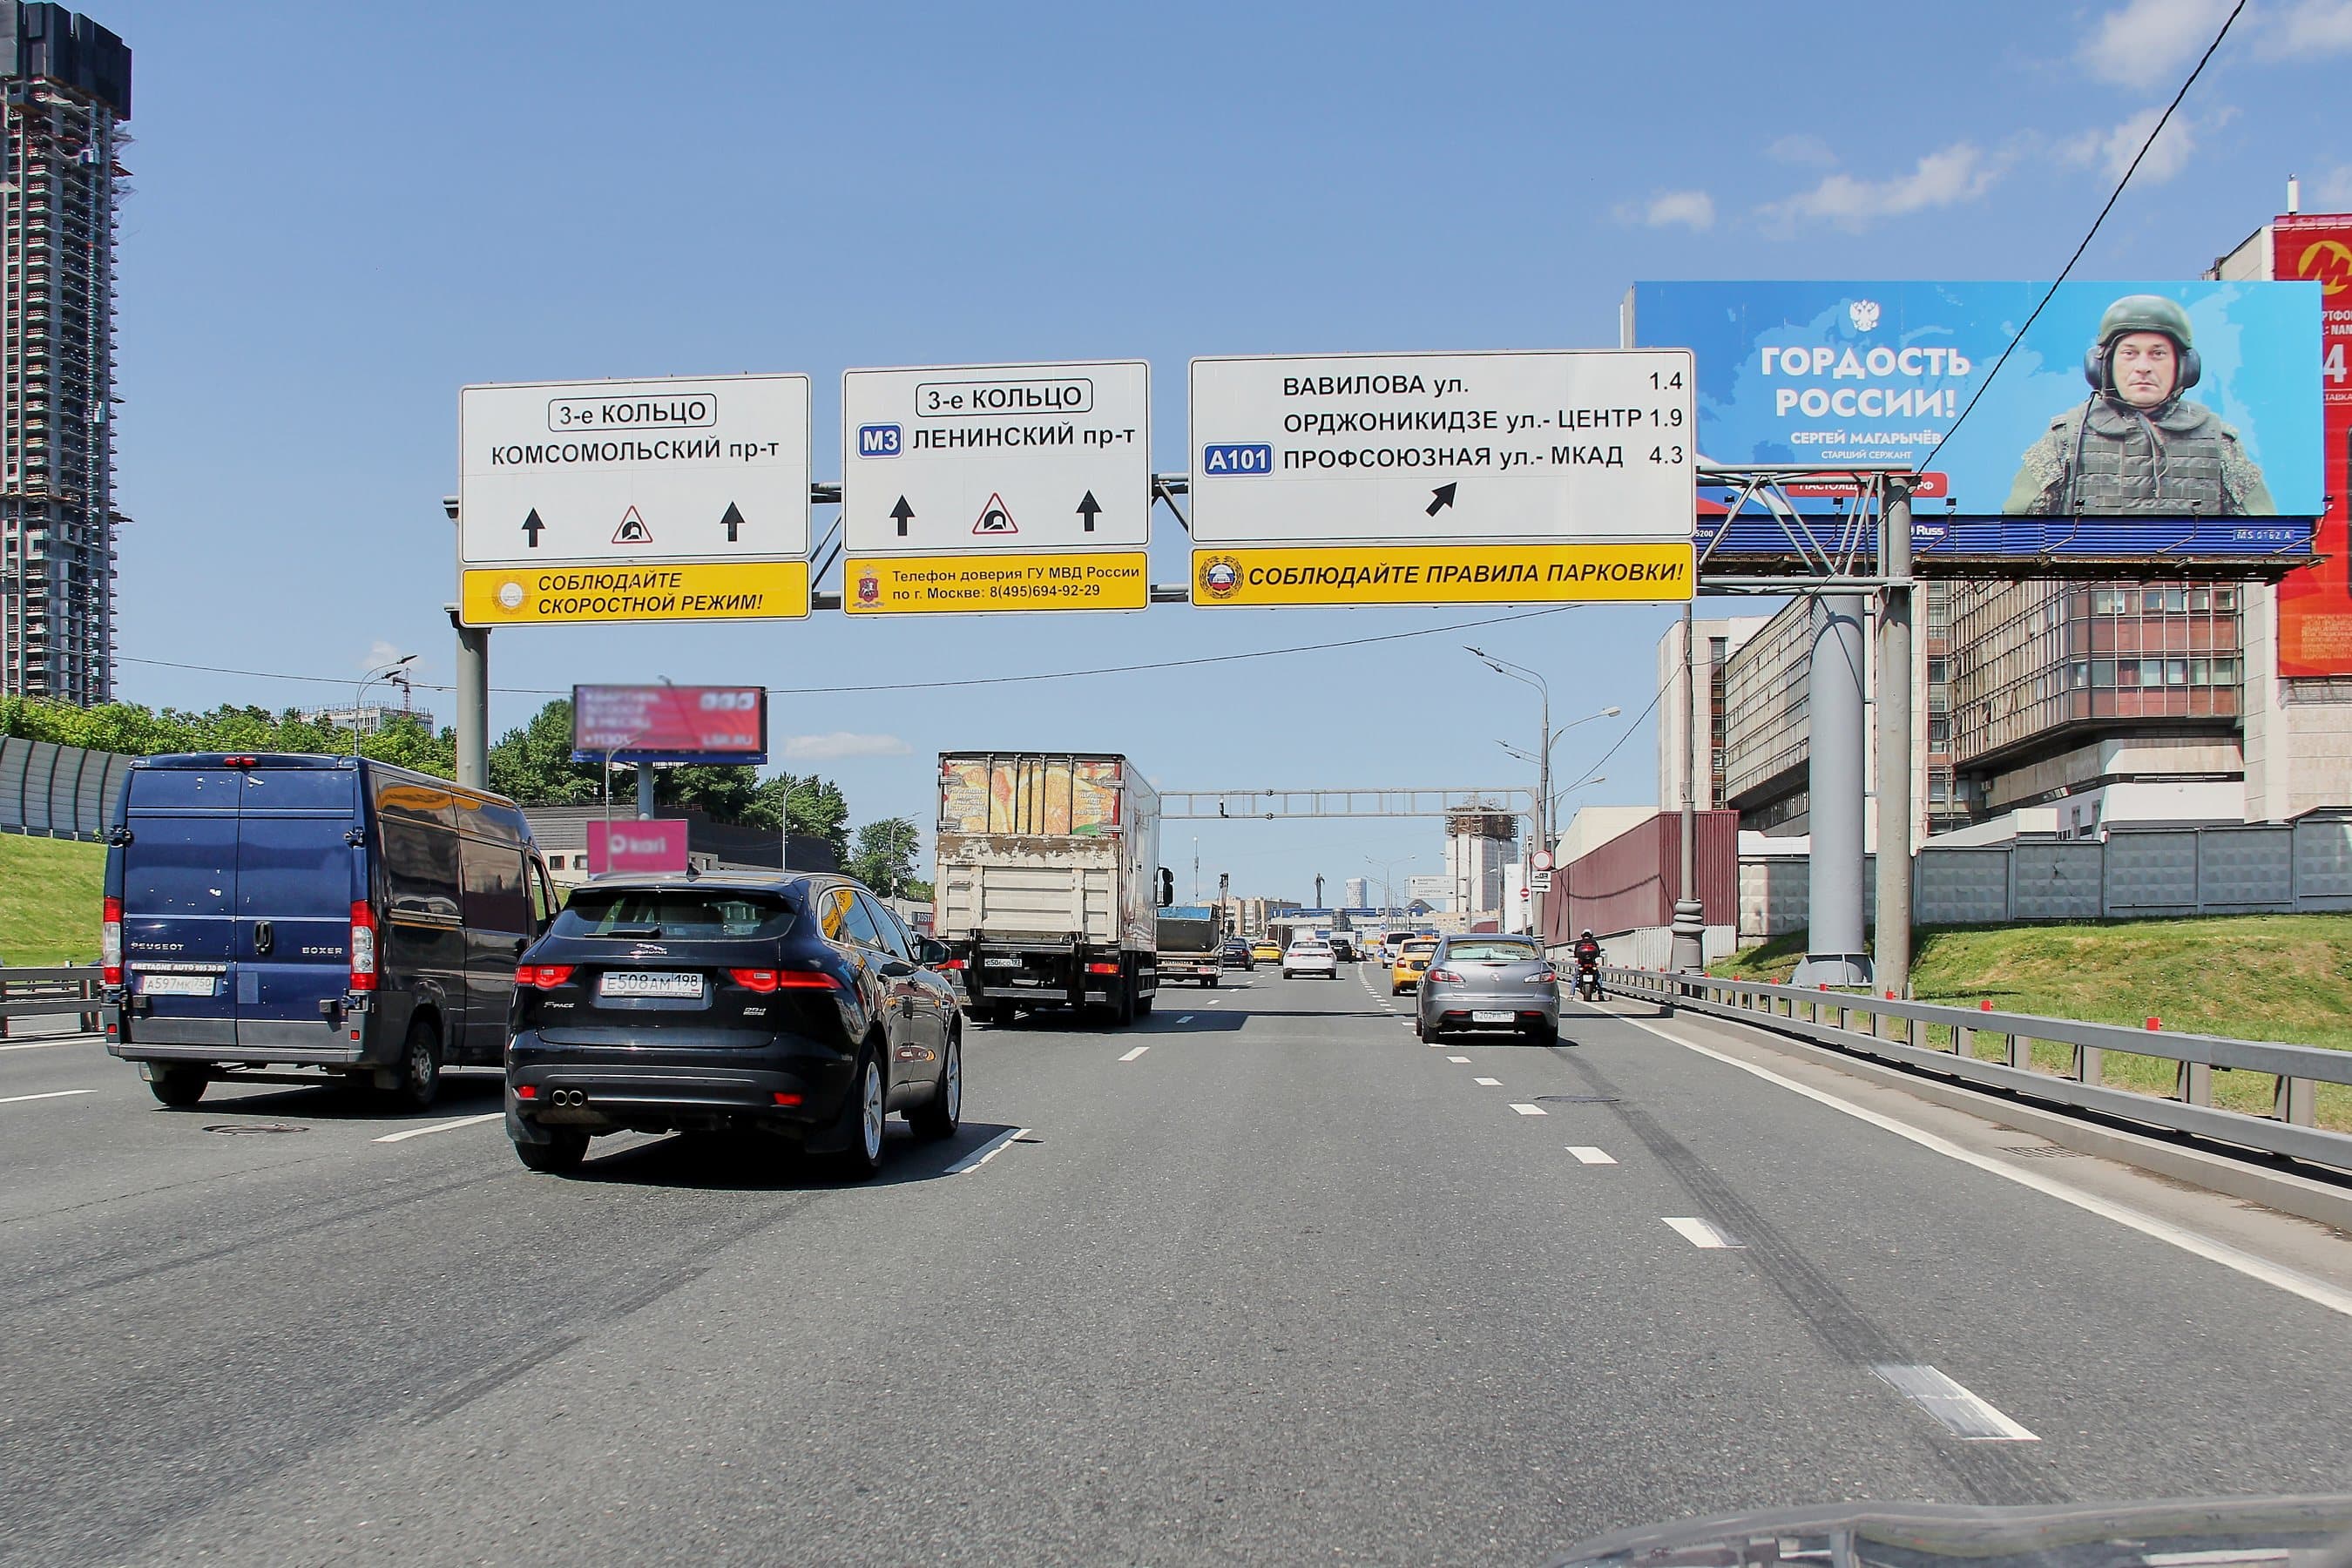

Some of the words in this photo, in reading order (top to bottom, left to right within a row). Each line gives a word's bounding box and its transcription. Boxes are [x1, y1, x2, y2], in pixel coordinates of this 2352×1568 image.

[2322, 310, 2352, 321] РТФО
[1761, 348, 1970, 379] ГОРДОСТЬ
[1283, 375, 1426, 397] ВАВИЛОВА
[1434, 376, 1470, 397] ул.
[1649, 371, 1683, 390] 1.4
[928, 390, 963, 409] 3-е
[972, 386, 1082, 409] КОЛЬЦО
[1775, 388, 1957, 418] РОССИИ!
[560, 406, 593, 425] 3-е
[601, 401, 706, 425] КОЛЬЦО
[1283, 410, 1498, 436] ОРДЖОНИКИДЗЕ
[1557, 408, 1642, 432] ЦЕНТР
[1649, 409, 1683, 428] 1.9
[913, 420, 1074, 449] ЛЕНИНСКИЙ
[1083, 428, 1136, 449] пр-т
[1790, 429, 1847, 444] СЕРГЕЙ
[1849, 429, 1943, 444] МАГАРЫЧЁВ
[491, 435, 720, 465] КОМСОМОЛЬСКИЙ
[729, 441, 780, 462] пр-т
[1207, 449, 1268, 470] А101
[1283, 446, 1491, 470] ПРОФСОЮЗНАЯ
[1551, 445, 1624, 468] МКАД
[1649, 445, 1683, 465] 4.3
[1821, 450, 1868, 460] СТАРШИЙ
[537, 570, 683, 593] СОБЛЮДАЙТЕ
[892, 569, 956, 584] Телефон
[960, 570, 1023, 584] доверия
[1026, 568, 1044, 581] ГУ
[1049, 567, 1082, 581] МВД
[1086, 566, 1139, 578] России
[1248, 559, 1420, 588] СОБЛЮДАЙТЕ
[1426, 564, 1540, 585] ПРАВИЛА
[1546, 562, 1684, 583] ПАРКОВКИ!
[537, 592, 675, 614] СКОРОСТНОЙ
[680, 594, 764, 612] РЕЖИМ!
[892, 590, 910, 600] по
[927, 587, 985, 599] Москве:
[990, 585, 1100, 599] 8(495)694-92-29
